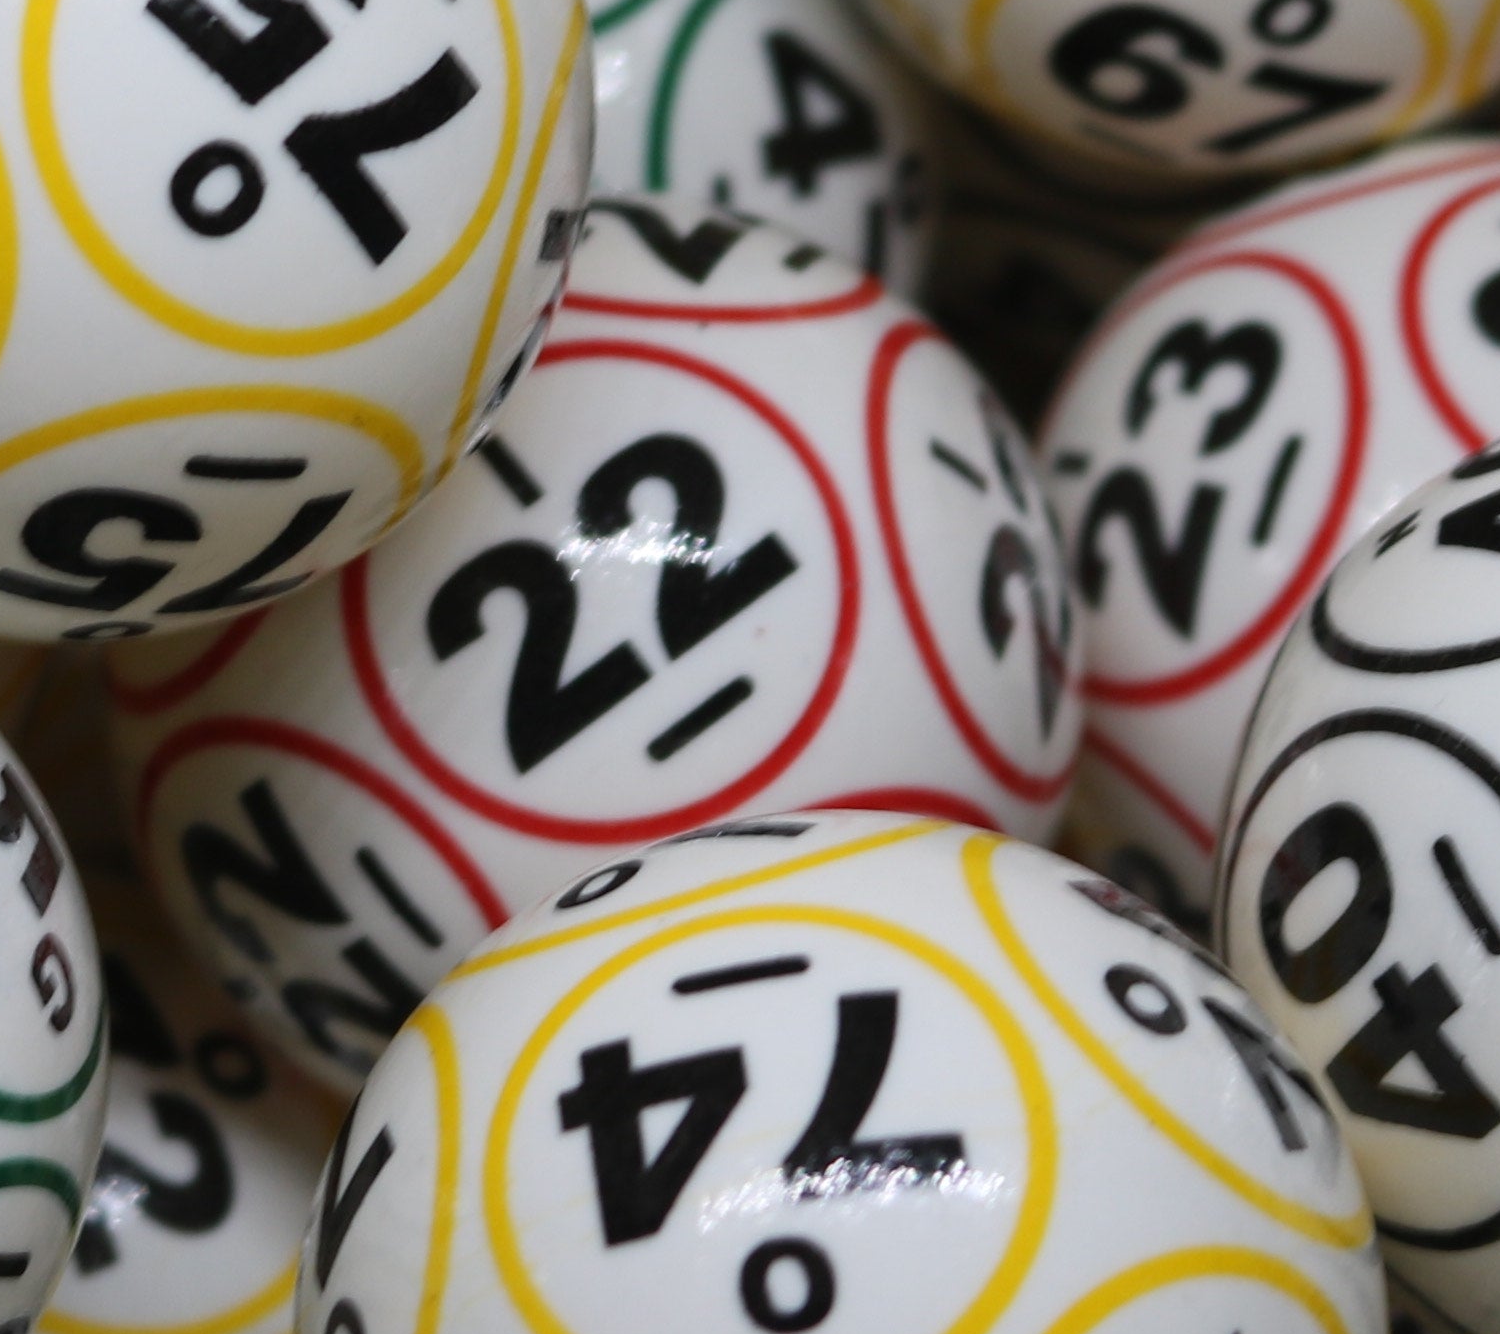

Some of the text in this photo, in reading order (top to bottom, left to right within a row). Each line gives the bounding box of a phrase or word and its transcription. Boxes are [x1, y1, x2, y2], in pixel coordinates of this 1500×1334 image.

[1046, 1, 1393, 157] 67
[168, 137, 267, 239] O
[1076, 317, 1284, 644] 23
[425, 430, 800, 778] 22
[30, 931, 76, 1035] G
[1102, 962, 1189, 1037] O
[555, 991, 967, 1249] 74
[738, 1236, 839, 1334] O
